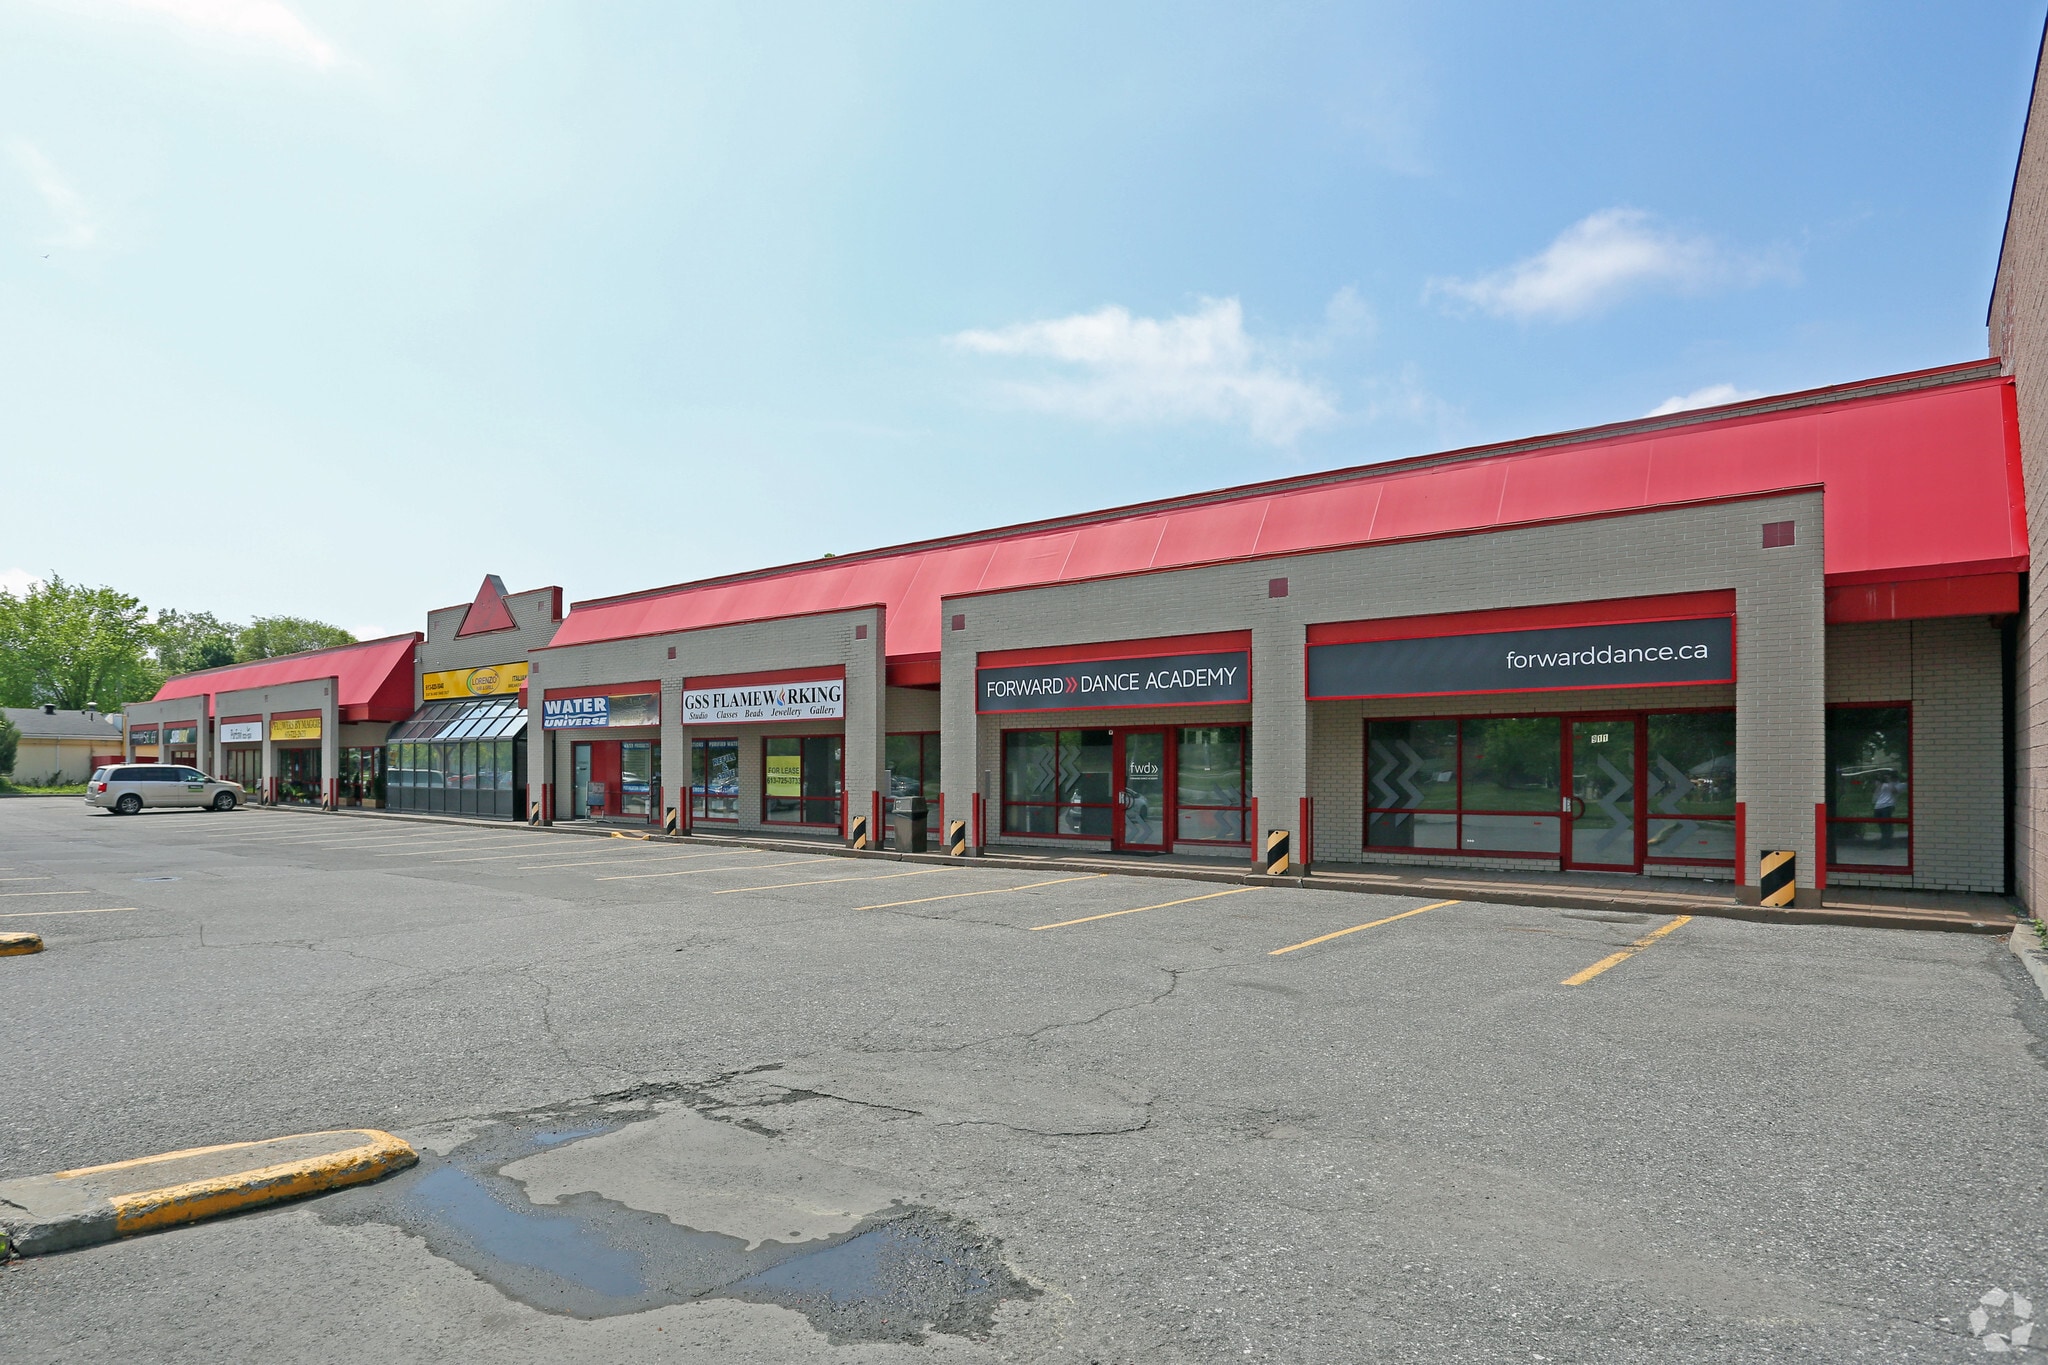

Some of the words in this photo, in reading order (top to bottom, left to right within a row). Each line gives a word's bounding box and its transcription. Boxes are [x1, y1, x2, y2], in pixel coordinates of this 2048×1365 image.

[1506, 644, 1708, 668] forwarddance.ca
[987, 677, 1064, 698] FORWARD
[1081, 672, 1140, 693] DANCE
[1145, 666, 1237, 690] ACADEMY
[544, 697, 607, 715] WATER
[685, 694, 710, 710] GSS
[689, 711, 709, 720] Studio
[716, 710, 738, 719] Classes
[744, 708, 764, 718] Beads
[771, 706, 802, 717] Jewellery
[809, 705, 836, 716] Gallery
[768, 767, 781, 775] FOR
[781, 766, 800, 775] LEASE
